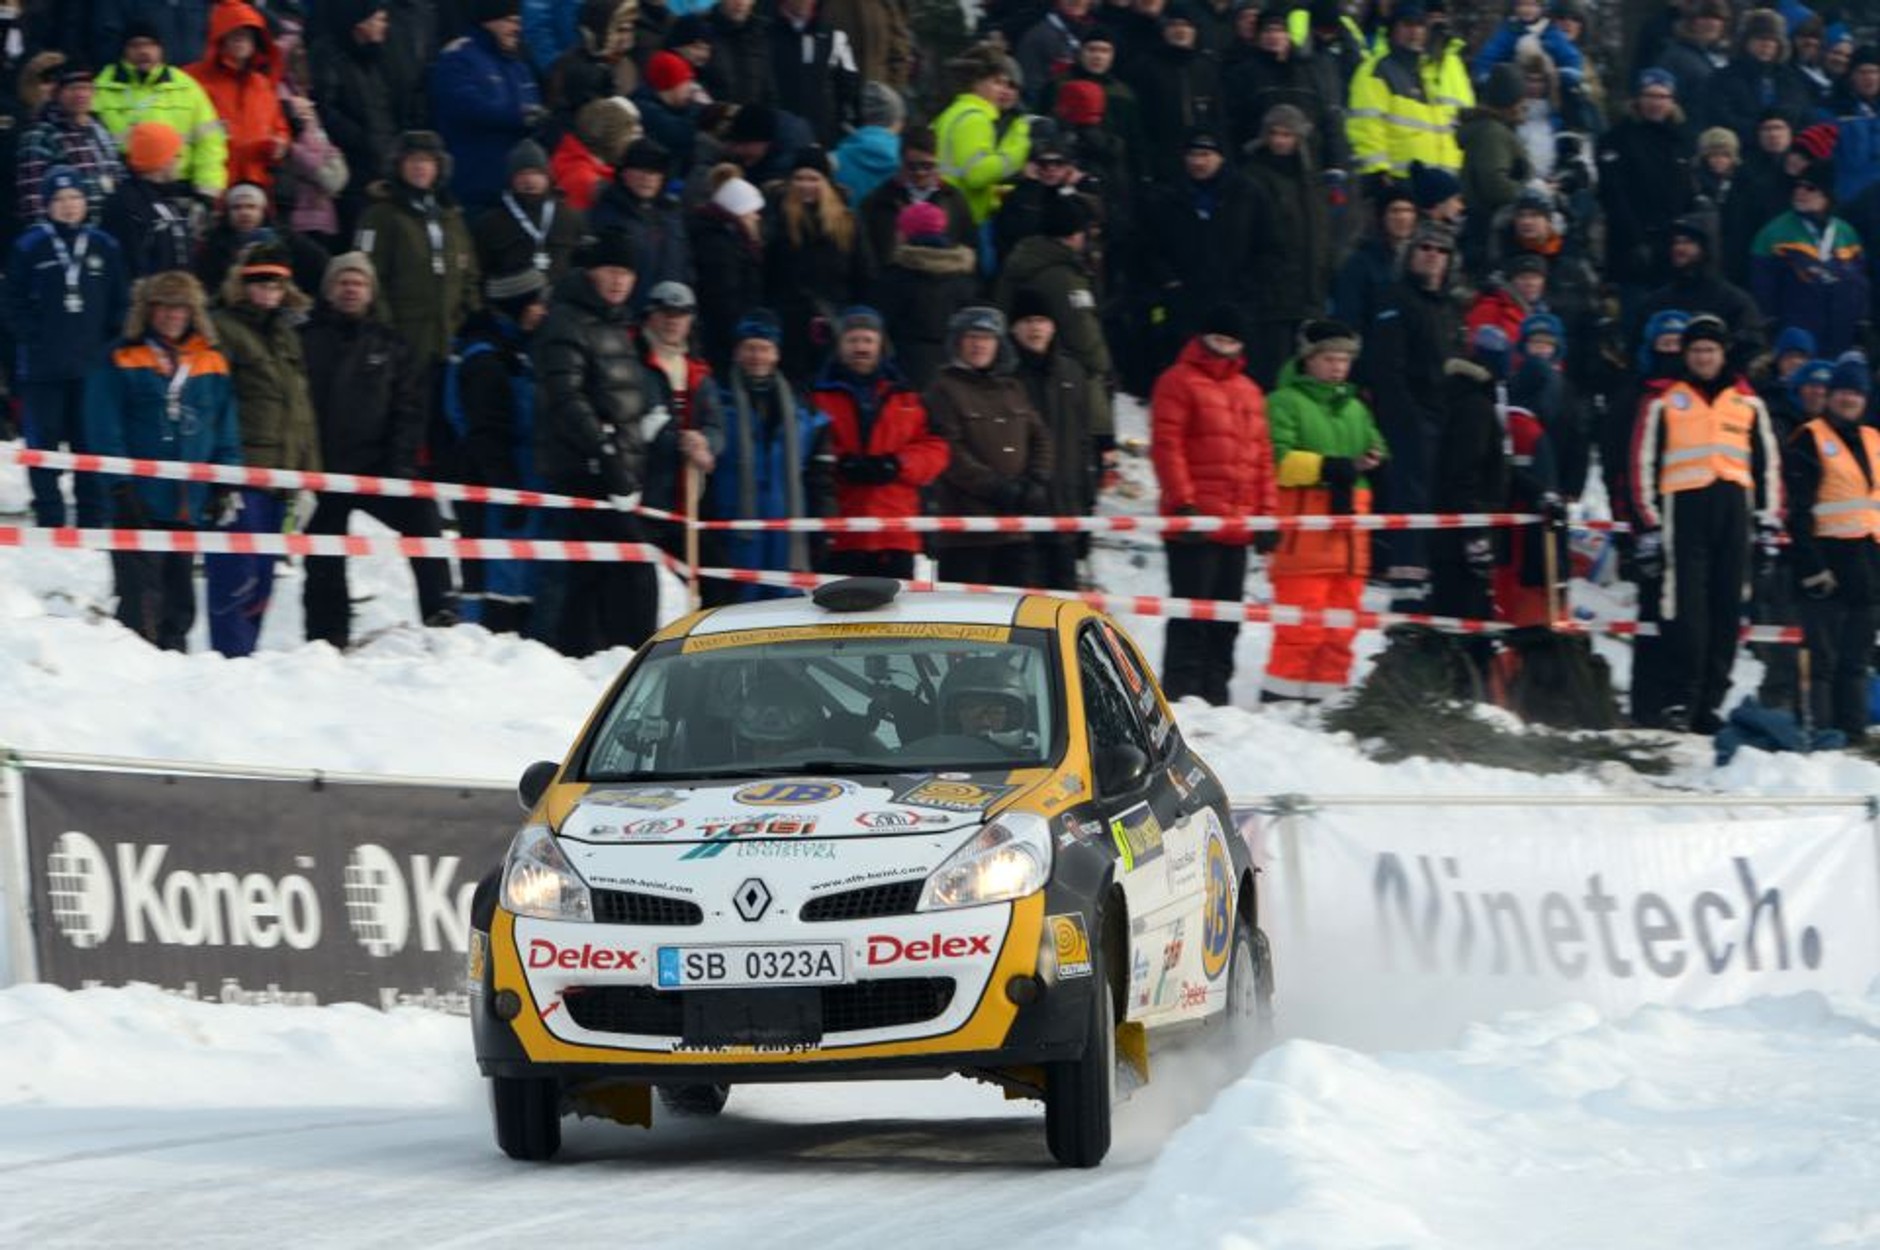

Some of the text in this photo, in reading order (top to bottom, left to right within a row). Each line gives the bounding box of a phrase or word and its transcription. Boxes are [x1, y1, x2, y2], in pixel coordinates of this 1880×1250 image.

[1374, 850, 1823, 979] Ninetech.
[528, 938, 637, 970] Delex
[686, 950, 837, 980] SB 0323A
[866, 934, 992, 967] Delex
